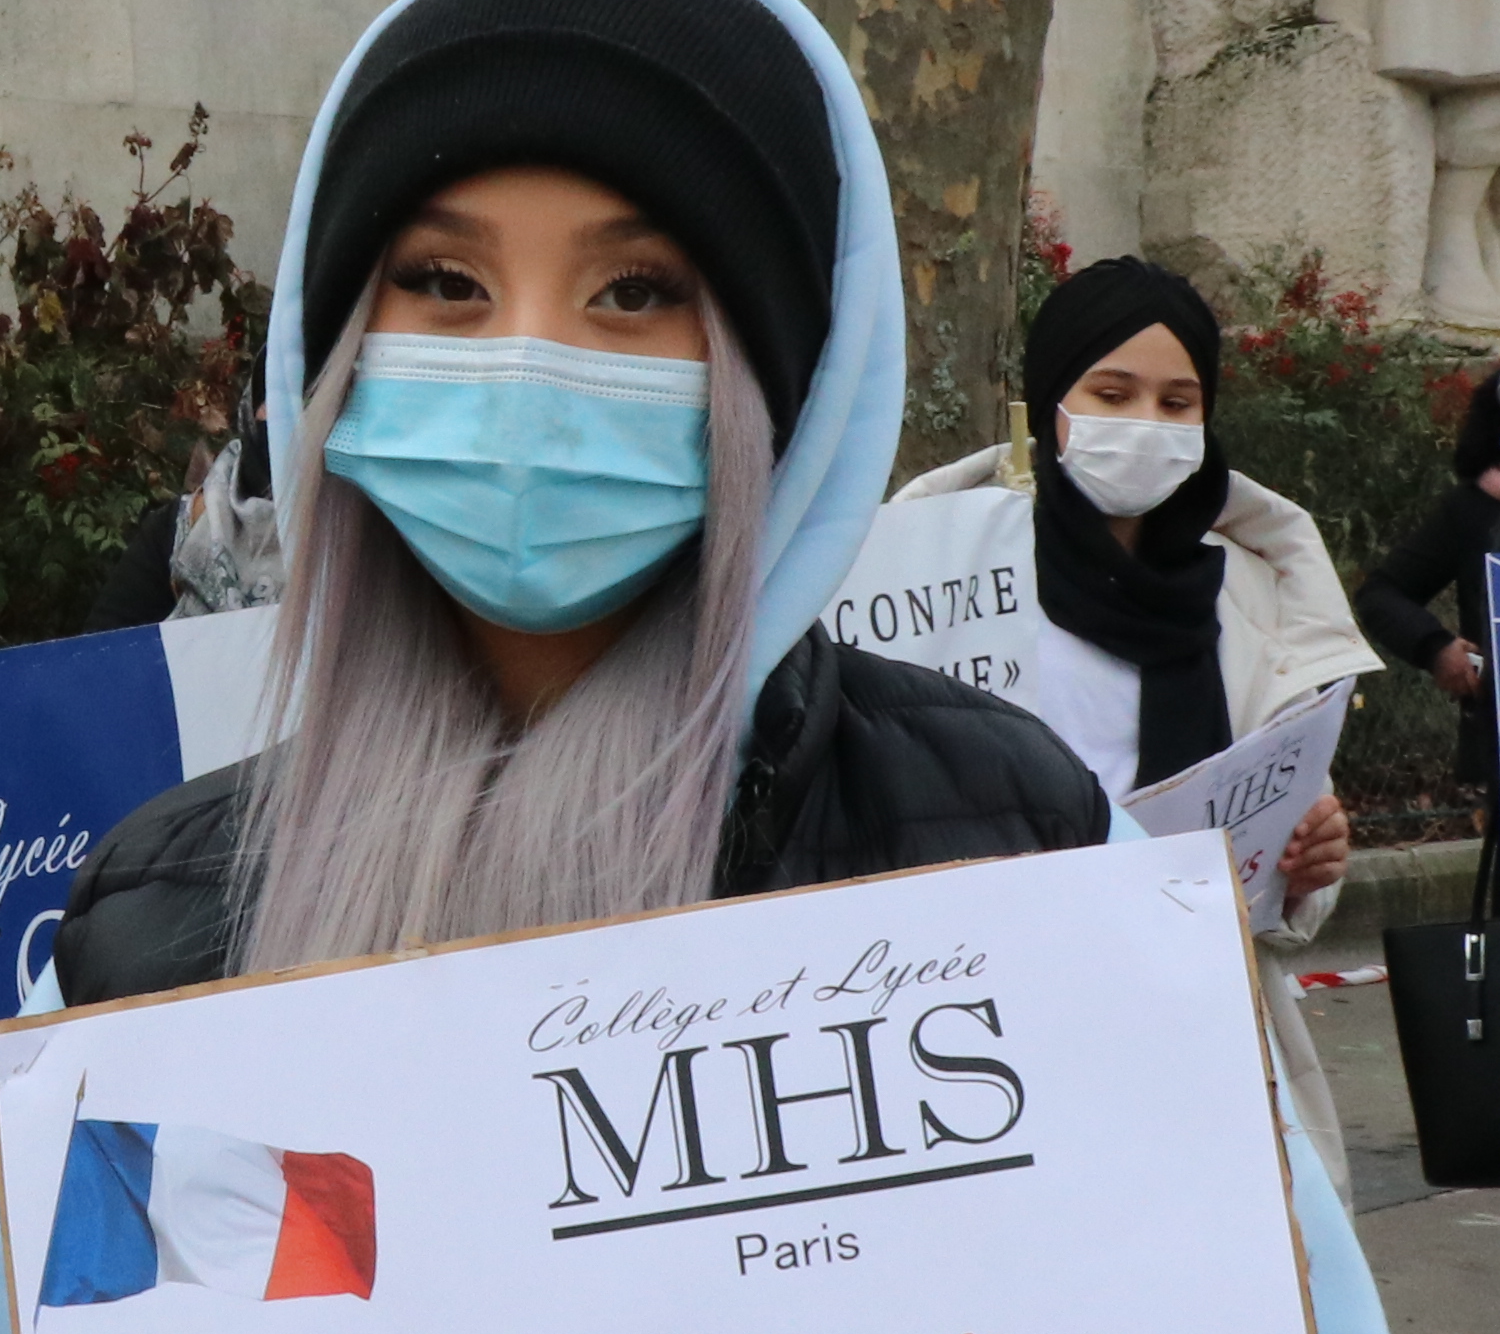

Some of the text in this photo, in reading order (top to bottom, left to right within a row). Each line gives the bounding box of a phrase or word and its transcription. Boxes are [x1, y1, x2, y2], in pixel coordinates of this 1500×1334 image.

[836, 566, 1018, 648] CONTRE
[1202, 747, 1302, 829] MHS
[528, 939, 988, 1052] Collège et Lycée
[531, 998, 1025, 1209] MHS
[735, 1223, 861, 1276] Paris
